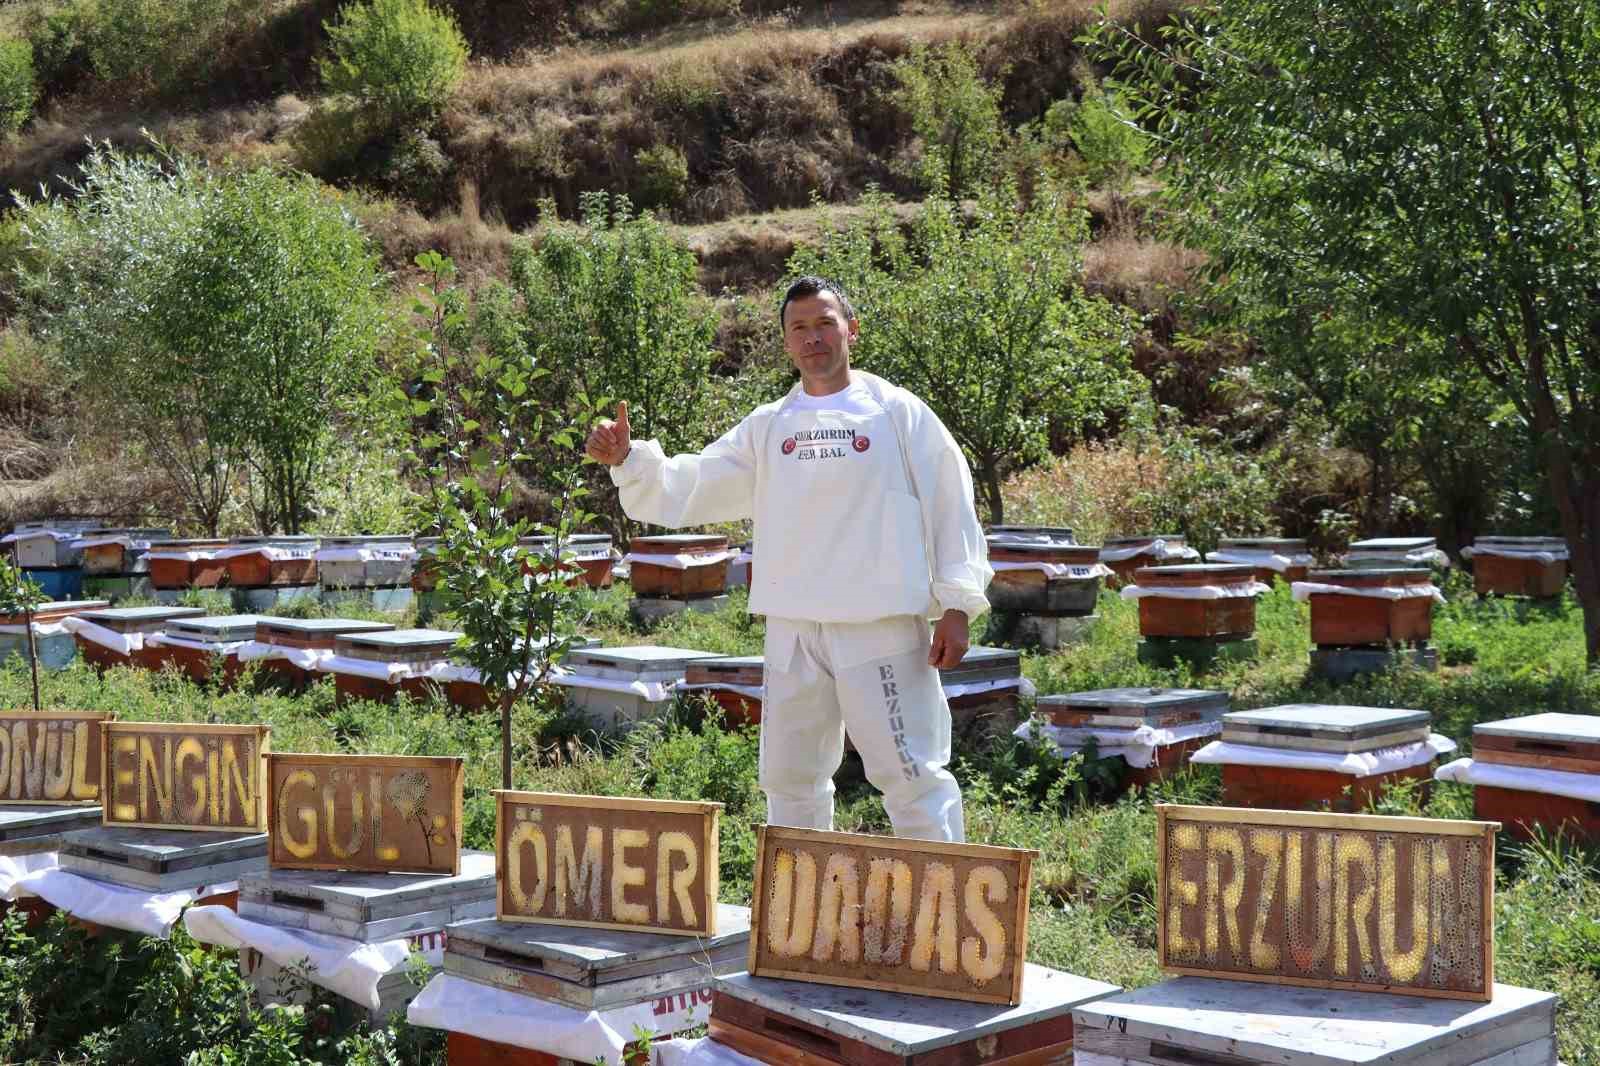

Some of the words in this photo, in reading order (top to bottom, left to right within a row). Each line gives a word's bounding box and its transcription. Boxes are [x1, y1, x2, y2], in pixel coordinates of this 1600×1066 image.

[820, 447, 846, 459] BAL
[879, 664, 920, 782] ERZURUM
[278, 767, 400, 862] GÜL
[507, 807, 698, 928] ÖMER
[1166, 823, 1481, 988] ERZURUM
